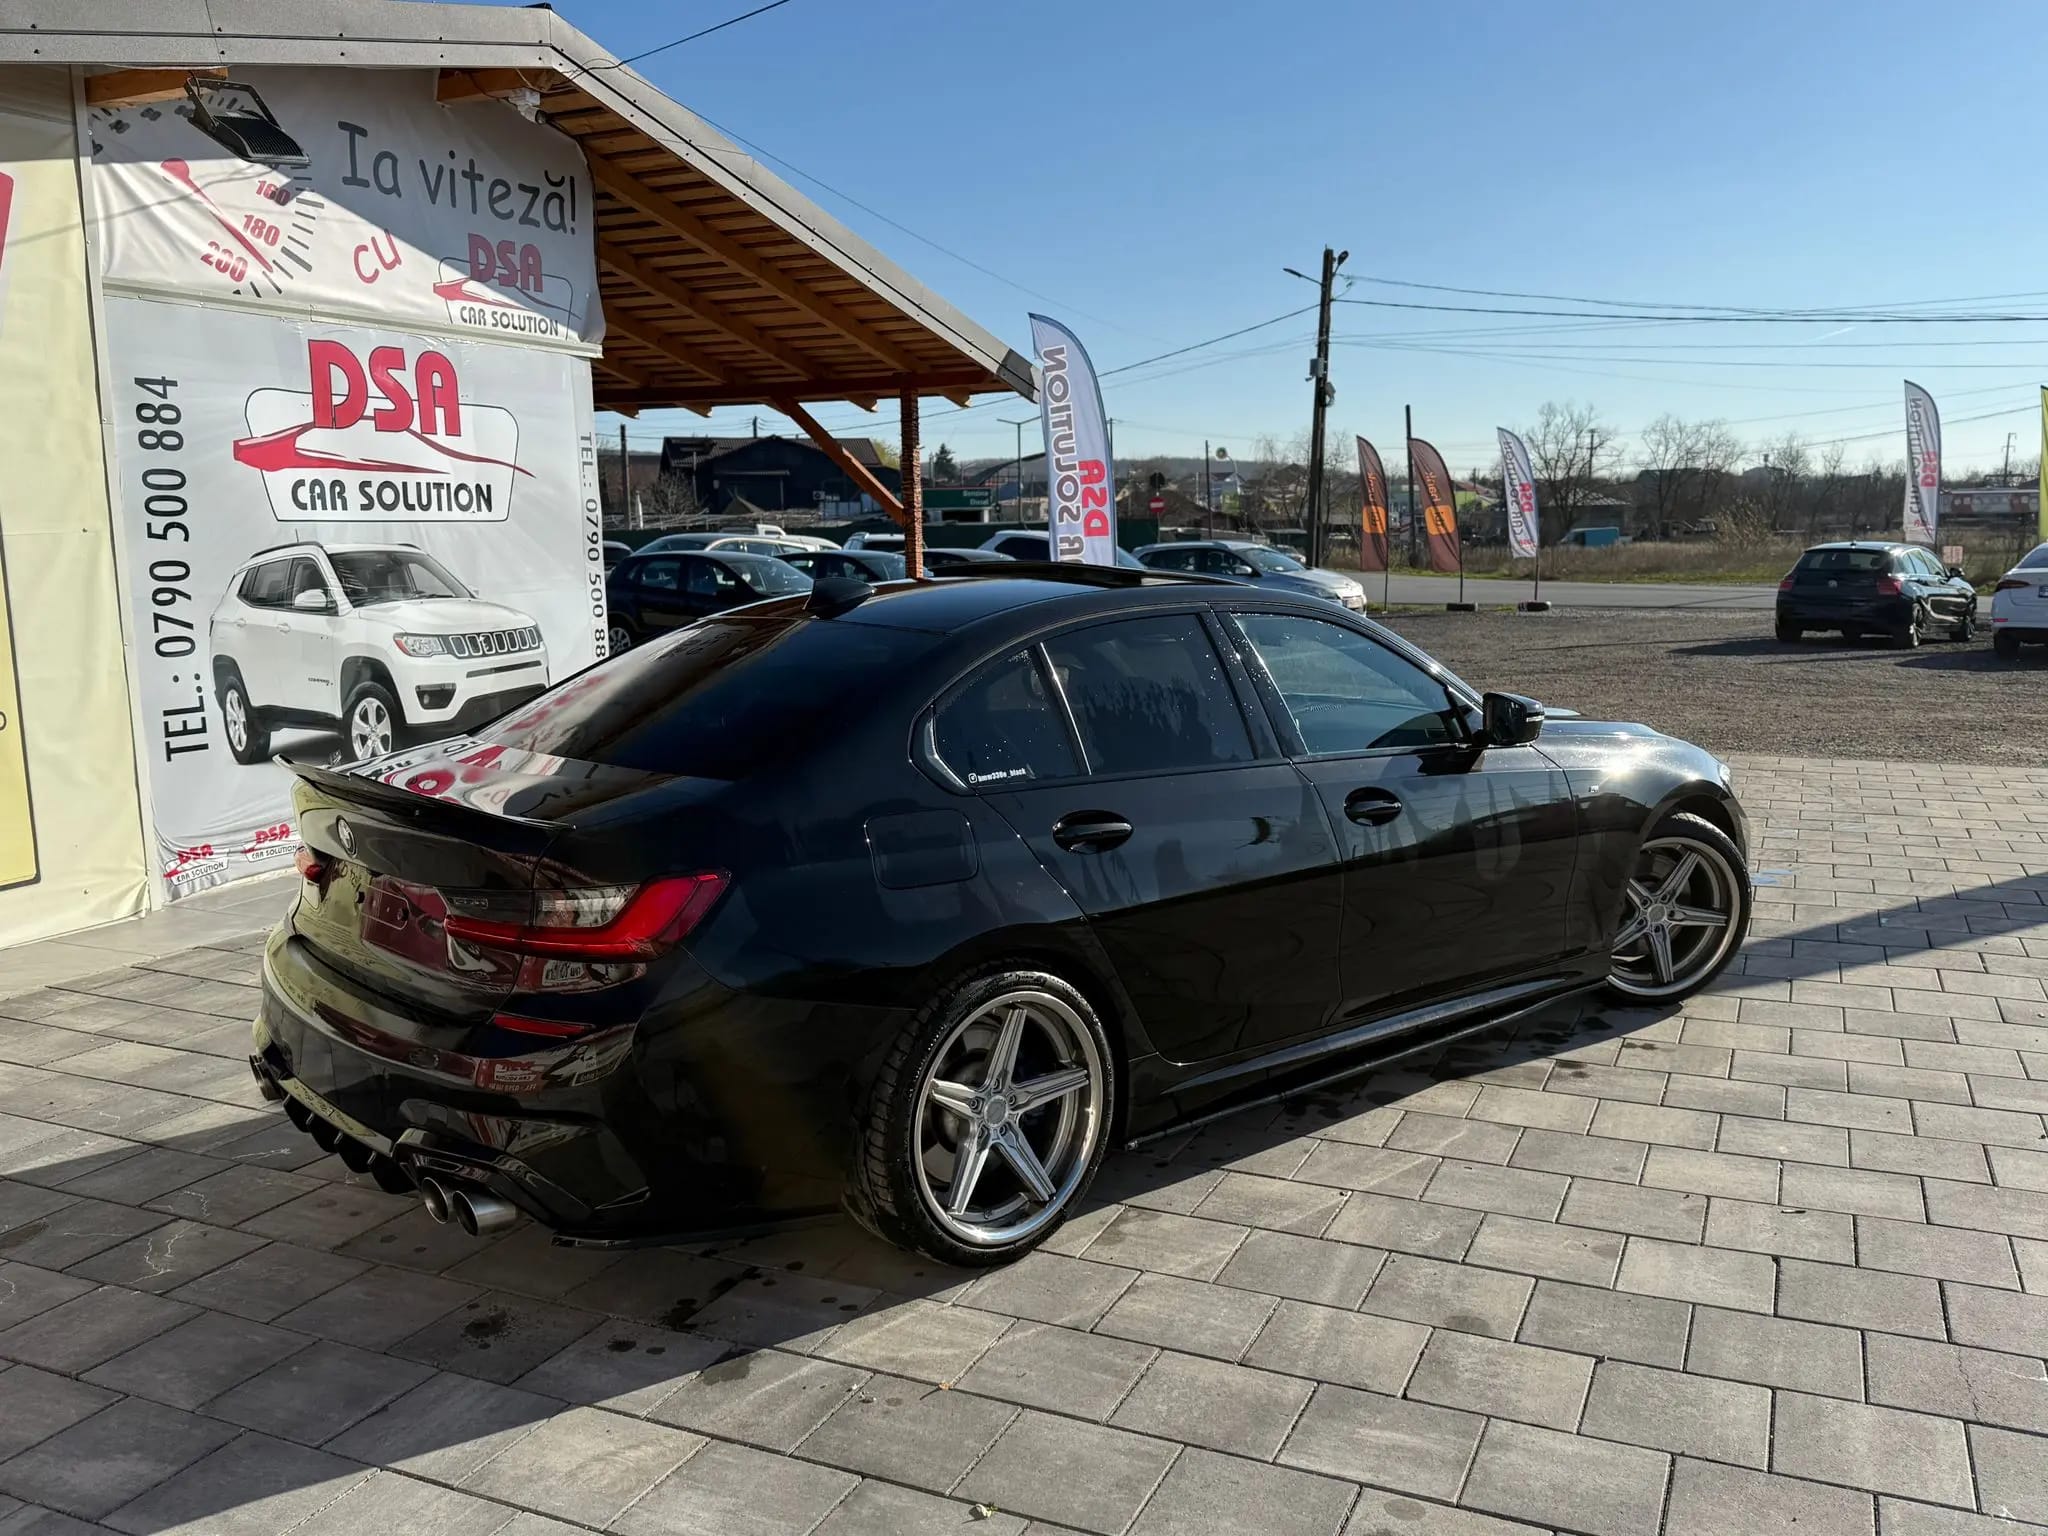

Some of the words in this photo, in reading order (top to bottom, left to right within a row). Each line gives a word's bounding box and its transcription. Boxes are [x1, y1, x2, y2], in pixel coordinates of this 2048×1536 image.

[256, 179, 291, 206] 160
[337, 120, 402, 198] Ia
[419, 150, 576, 235] viteză!
[243, 214, 281, 247] 180
[353, 228, 402, 284] cu
[200, 240, 249, 283] 200
[467, 232, 544, 293] DSA
[460, 304, 487, 326] CAR
[492, 310, 559, 337] SOLUTION
[307, 338, 462, 437] DSA
[134, 375, 185, 452] 884
[580, 432, 593, 488] TEL.:
[141, 468, 190, 543] 500
[291, 478, 348, 511] CAR
[358, 480, 493, 513] SOLUTION
[585, 497, 600, 562] 0790
[148, 559, 197, 659] 0790
[588, 572, 604, 618] 500
[163, 672, 210, 763] TEL.:
[177, 844, 214, 864] DSA
[251, 851, 265, 860] CAR
[265, 843, 297, 856] SOLUTION
[255, 824, 290, 844] DSA
[176, 873, 191, 882] CAR
[191, 861, 224, 877] SOLUTION
